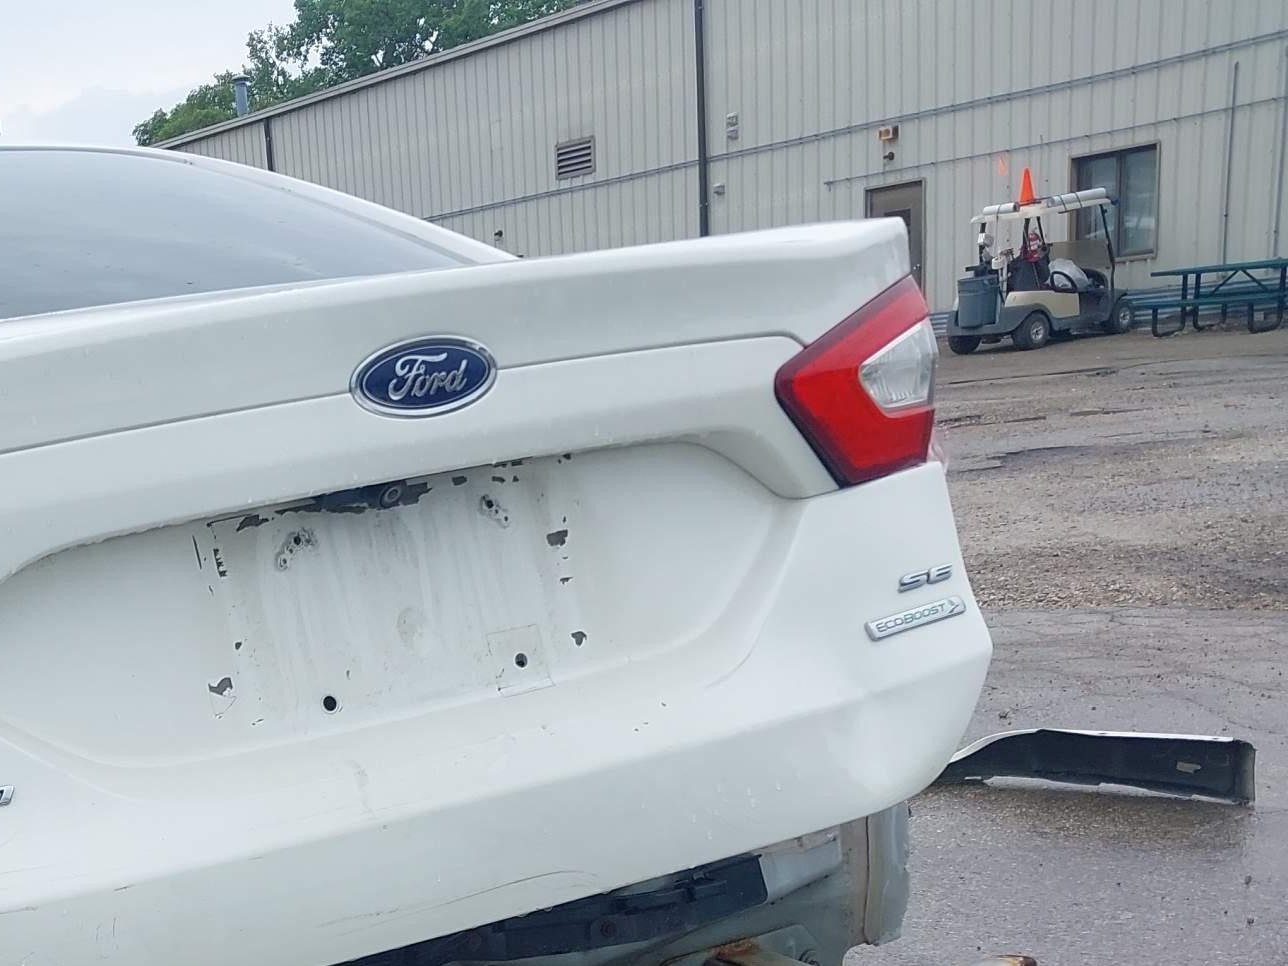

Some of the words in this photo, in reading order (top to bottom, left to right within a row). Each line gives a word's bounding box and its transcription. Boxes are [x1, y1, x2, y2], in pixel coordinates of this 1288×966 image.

[388, 352, 468, 400] Ford
[898, 563, 953, 594] SE
[875, 602, 946, 633] ECOBOOST
